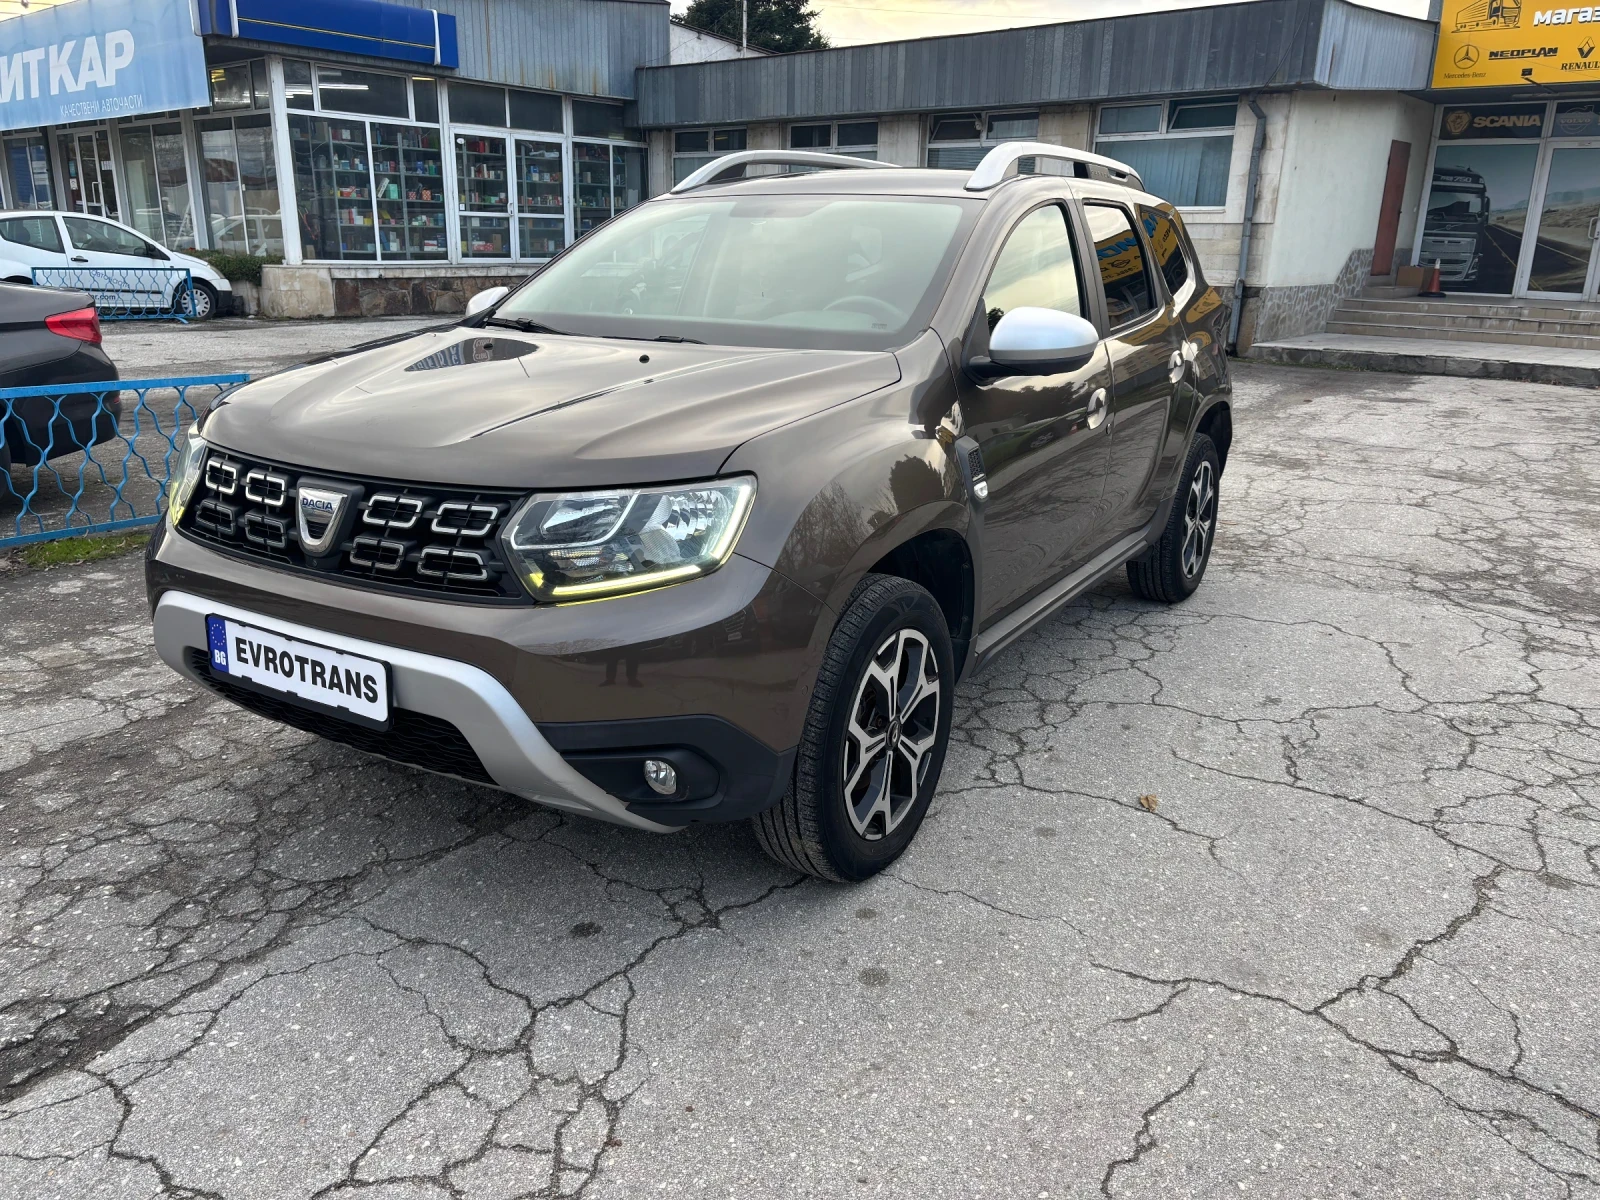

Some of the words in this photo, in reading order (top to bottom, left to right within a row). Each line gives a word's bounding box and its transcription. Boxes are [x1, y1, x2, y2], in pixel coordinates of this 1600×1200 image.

[1488, 47, 1558, 59] NEOPLAN
[1560, 61, 1600, 71] RENAUL
[0, 47, 45, 104] ИТ
[1443, 71, 1487, 79] Mercedes-Benz
[60, 100, 100, 117] КАЧЕСТВЕНИ
[101, 94, 144, 113] АВТОЧАСТИ
[1472, 115, 1541, 128] SCANIA
[302, 498, 333, 511] DACIA
[214, 649, 227, 666] BG
[235, 636, 379, 704] EVROTRANS
